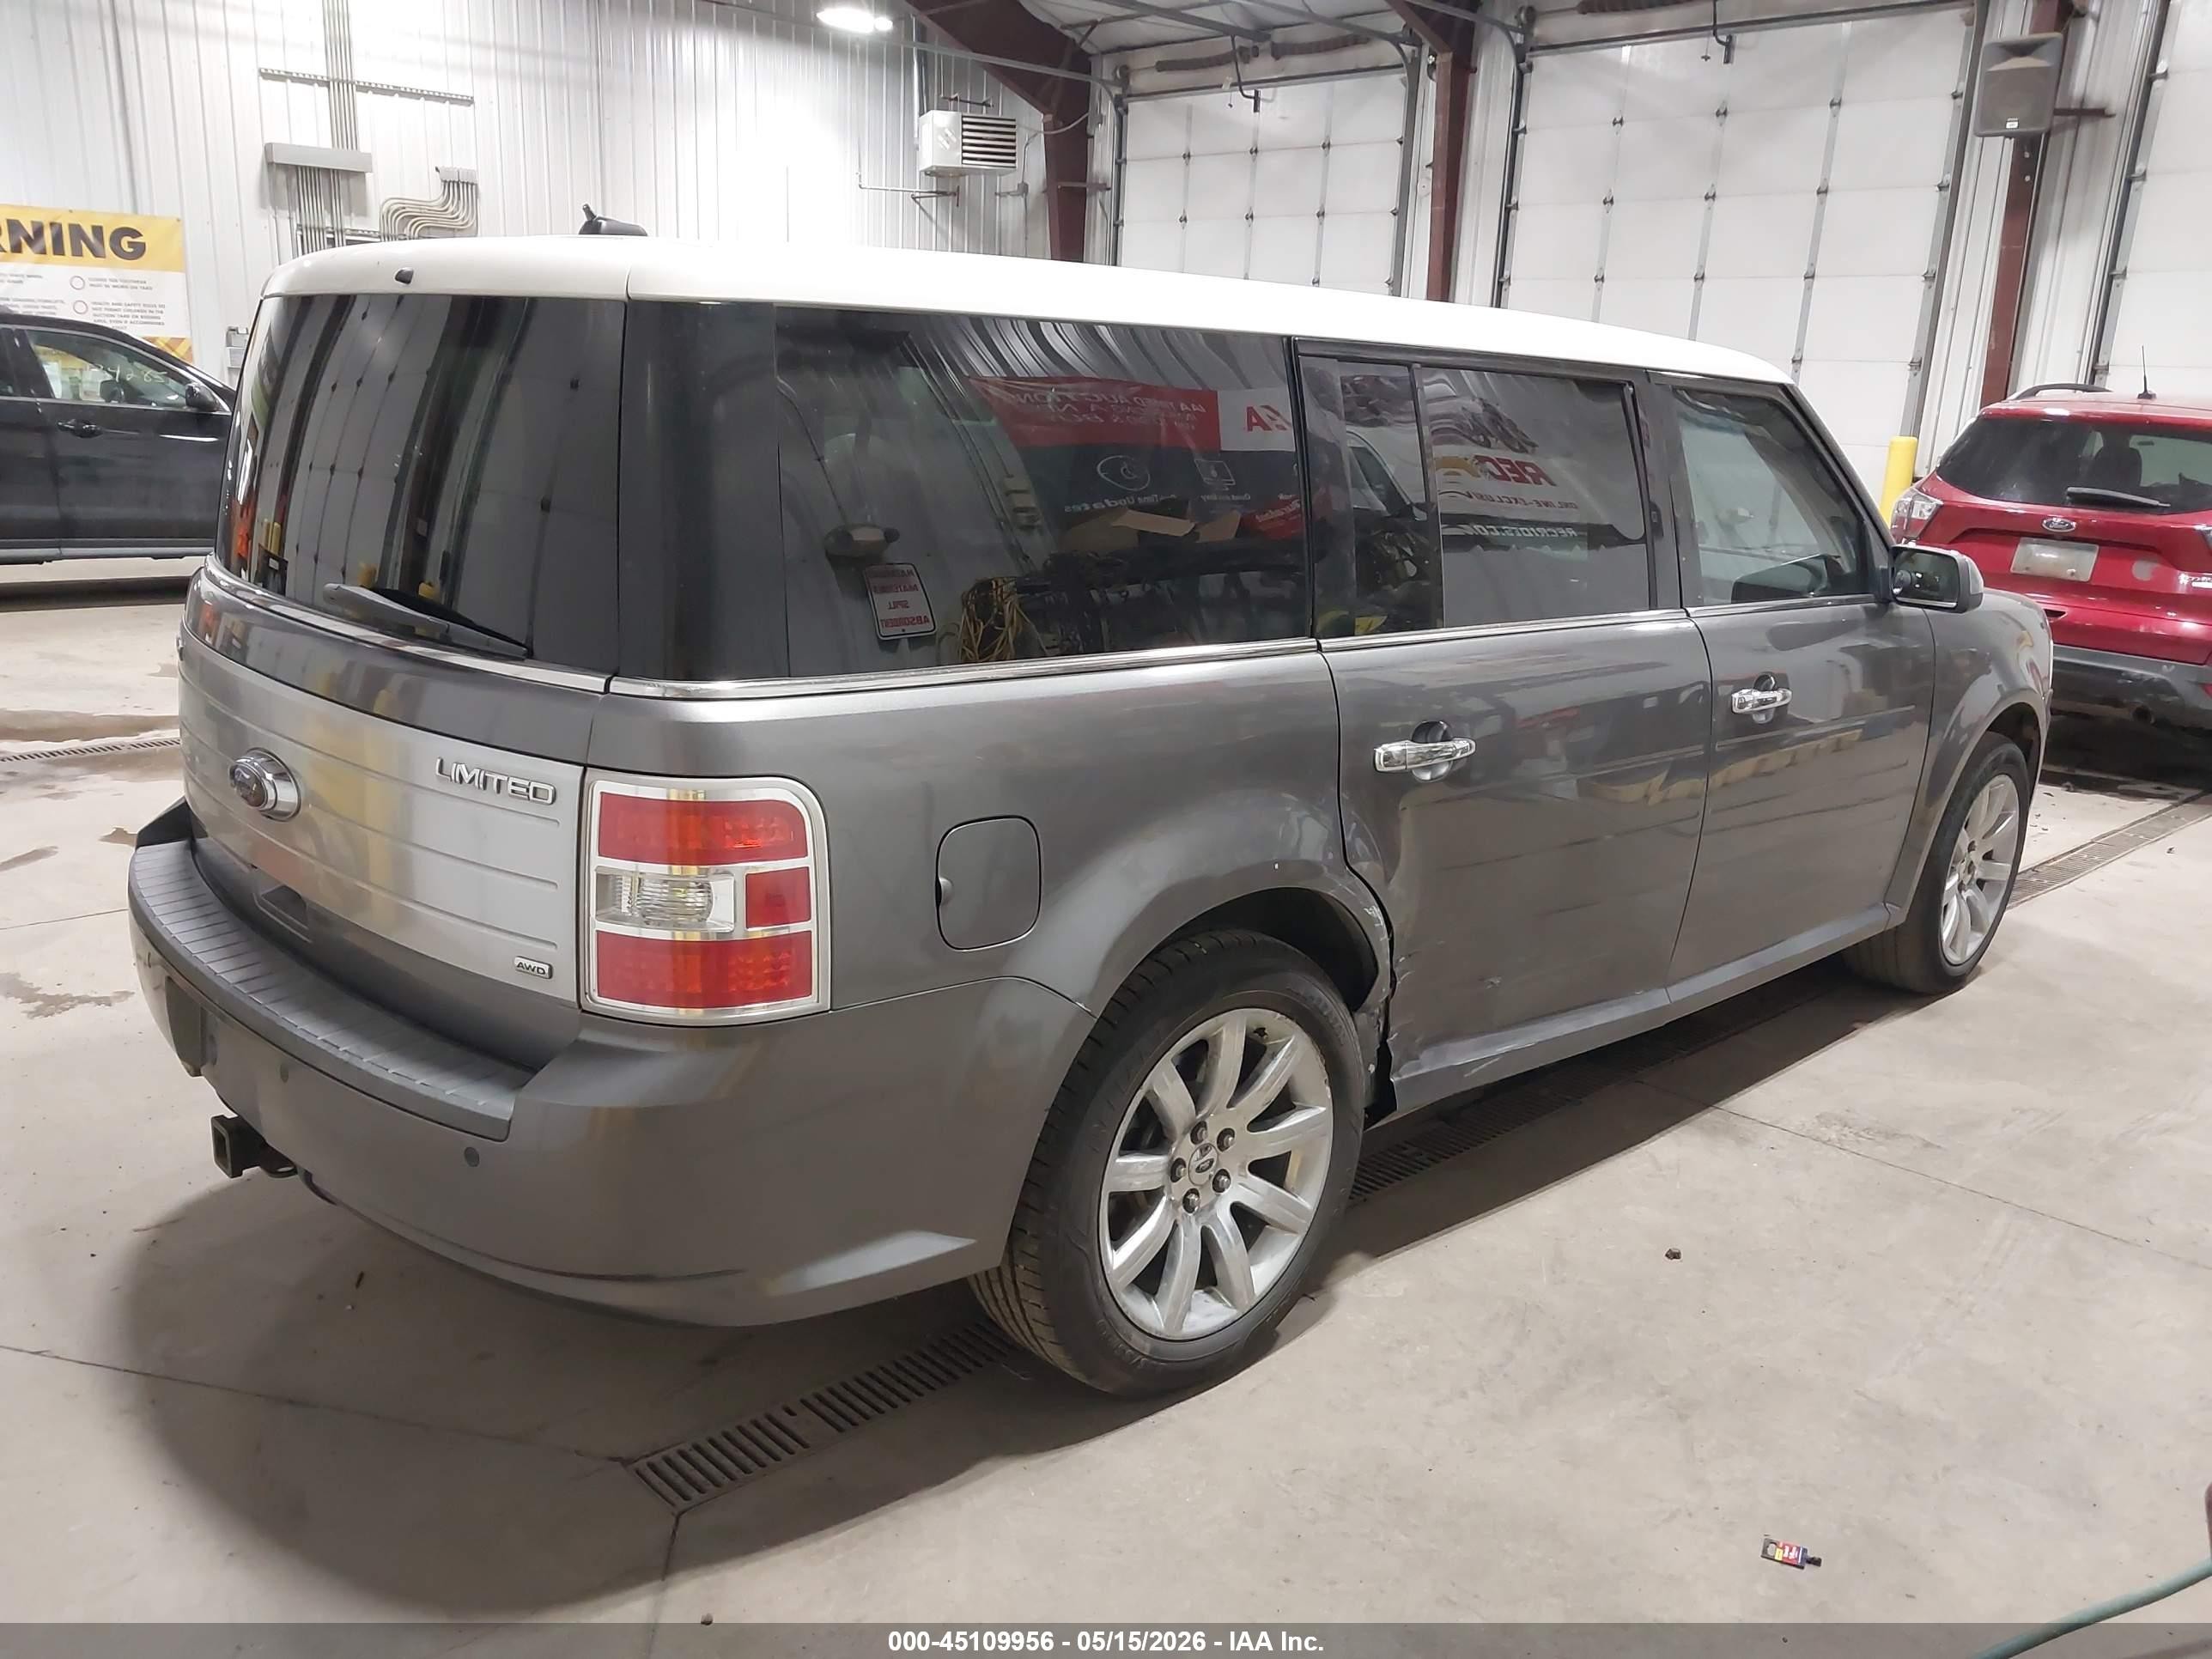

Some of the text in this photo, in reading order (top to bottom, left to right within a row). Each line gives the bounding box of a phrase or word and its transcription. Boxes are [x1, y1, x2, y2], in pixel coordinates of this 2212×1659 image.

[0, 218, 146, 261] NING
[435, 757, 557, 805] LIMITED
[516, 961, 546, 976] AWD
